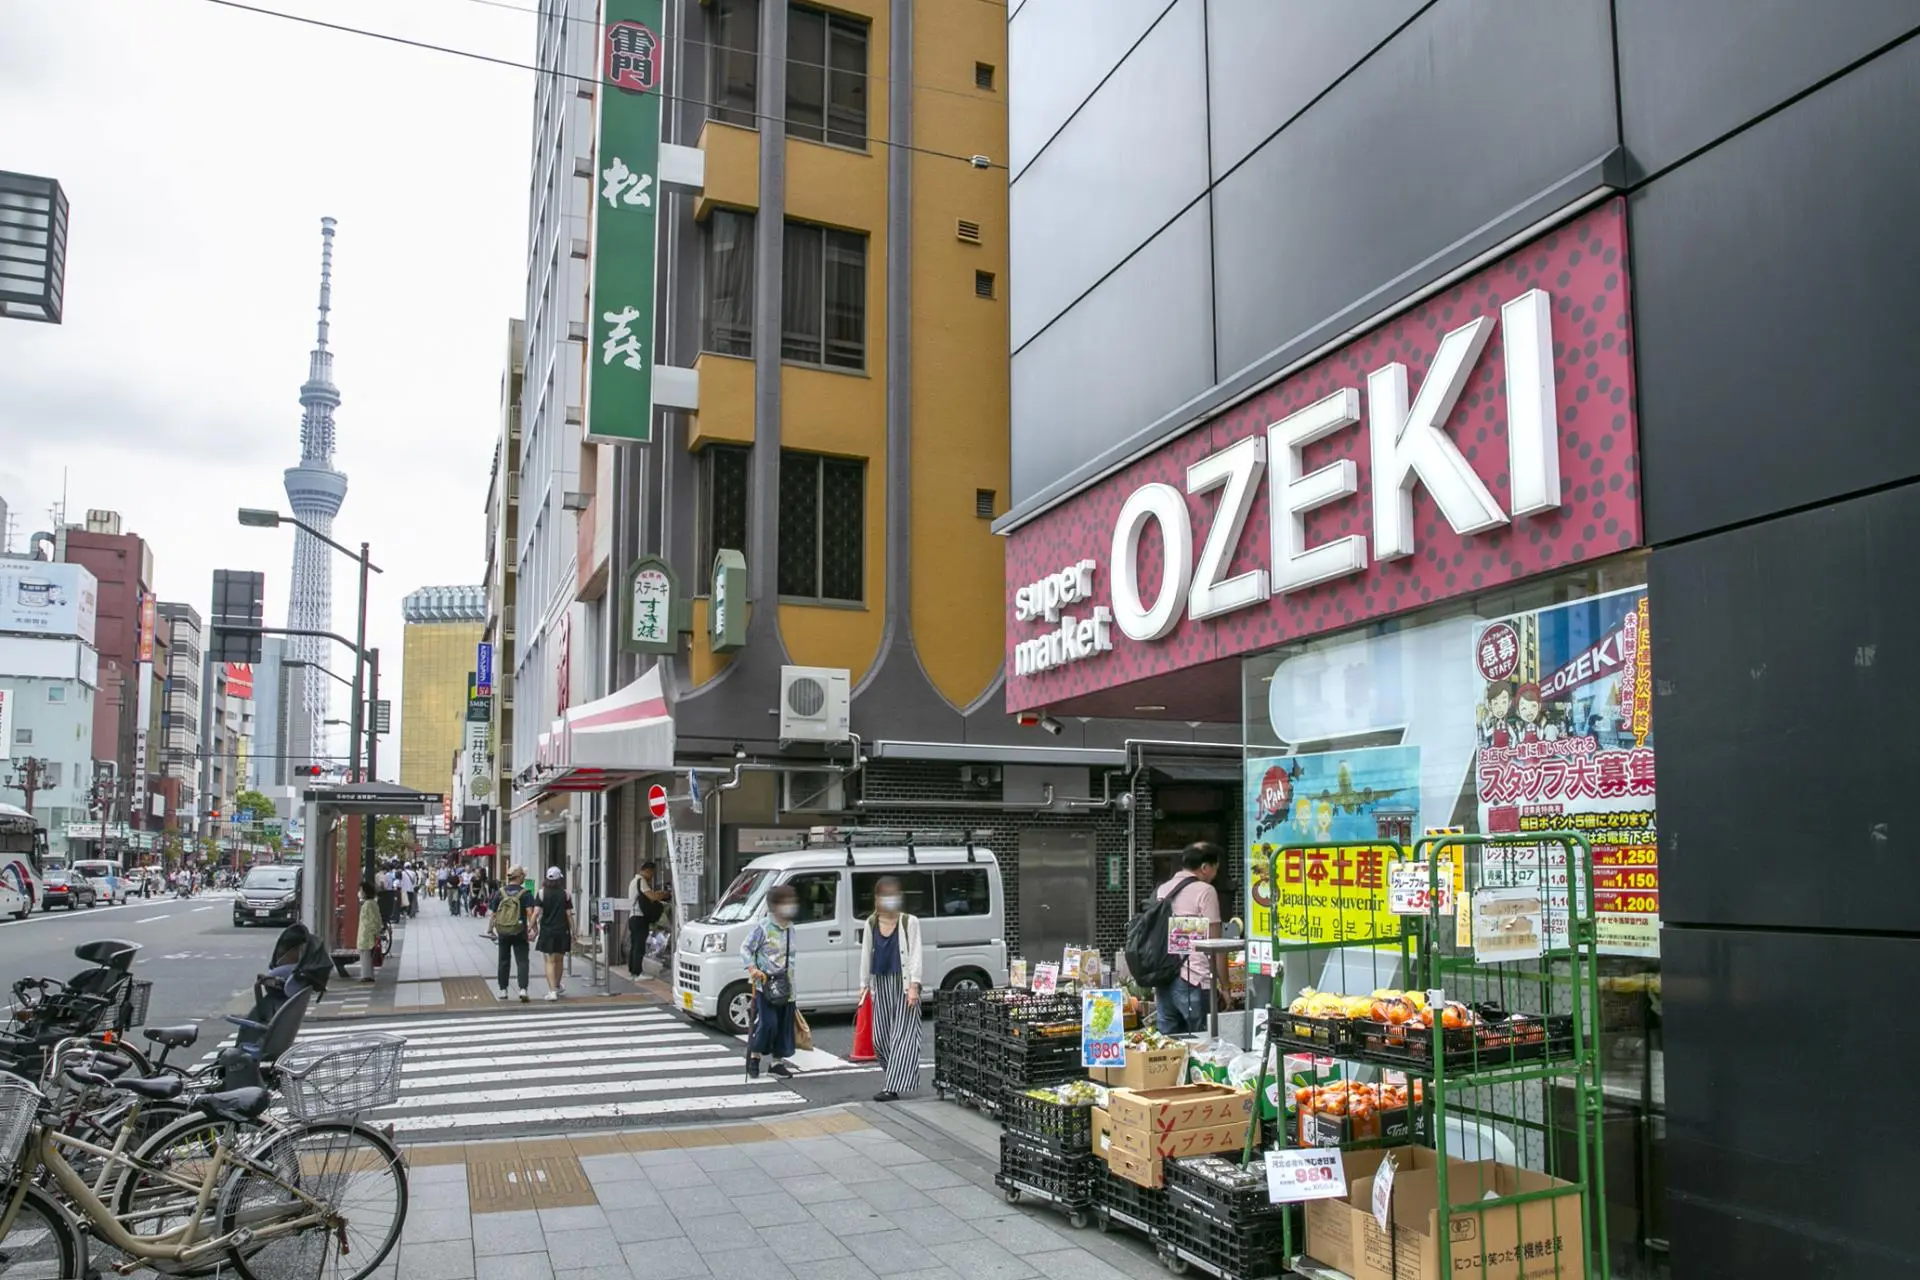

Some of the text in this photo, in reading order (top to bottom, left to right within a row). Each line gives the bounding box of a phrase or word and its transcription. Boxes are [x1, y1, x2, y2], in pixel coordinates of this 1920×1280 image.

[608, 24, 656, 88] 雷門
[1109, 287, 1561, 642] OZEKI
[635, 580, 668, 597] ステーキ
[1014, 558, 1096, 625] super
[637, 597, 661, 640] すき焼
[1014, 605, 1113, 676] market
[1481, 634, 1516, 669] 急募
[1488, 660, 1513, 678] STAFF
[1554, 630, 1625, 691] OZEKI
[1480, 750, 1656, 803] スタッフ大募集
[1284, 848, 1383, 890] 日本土産
[1615, 850, 1656, 865] 1,250
[1615, 874, 1655, 889] 1,150
[1281, 889, 1384, 912] japanese souvenir
[1614, 897, 1655, 912] 1,200
[1090, 1042, 1120, 1059] 1380
[1182, 1105, 1232, 1123] プラム
[1182, 1132, 1233, 1151] プラム
[1295, 1166, 1333, 1183] 980
